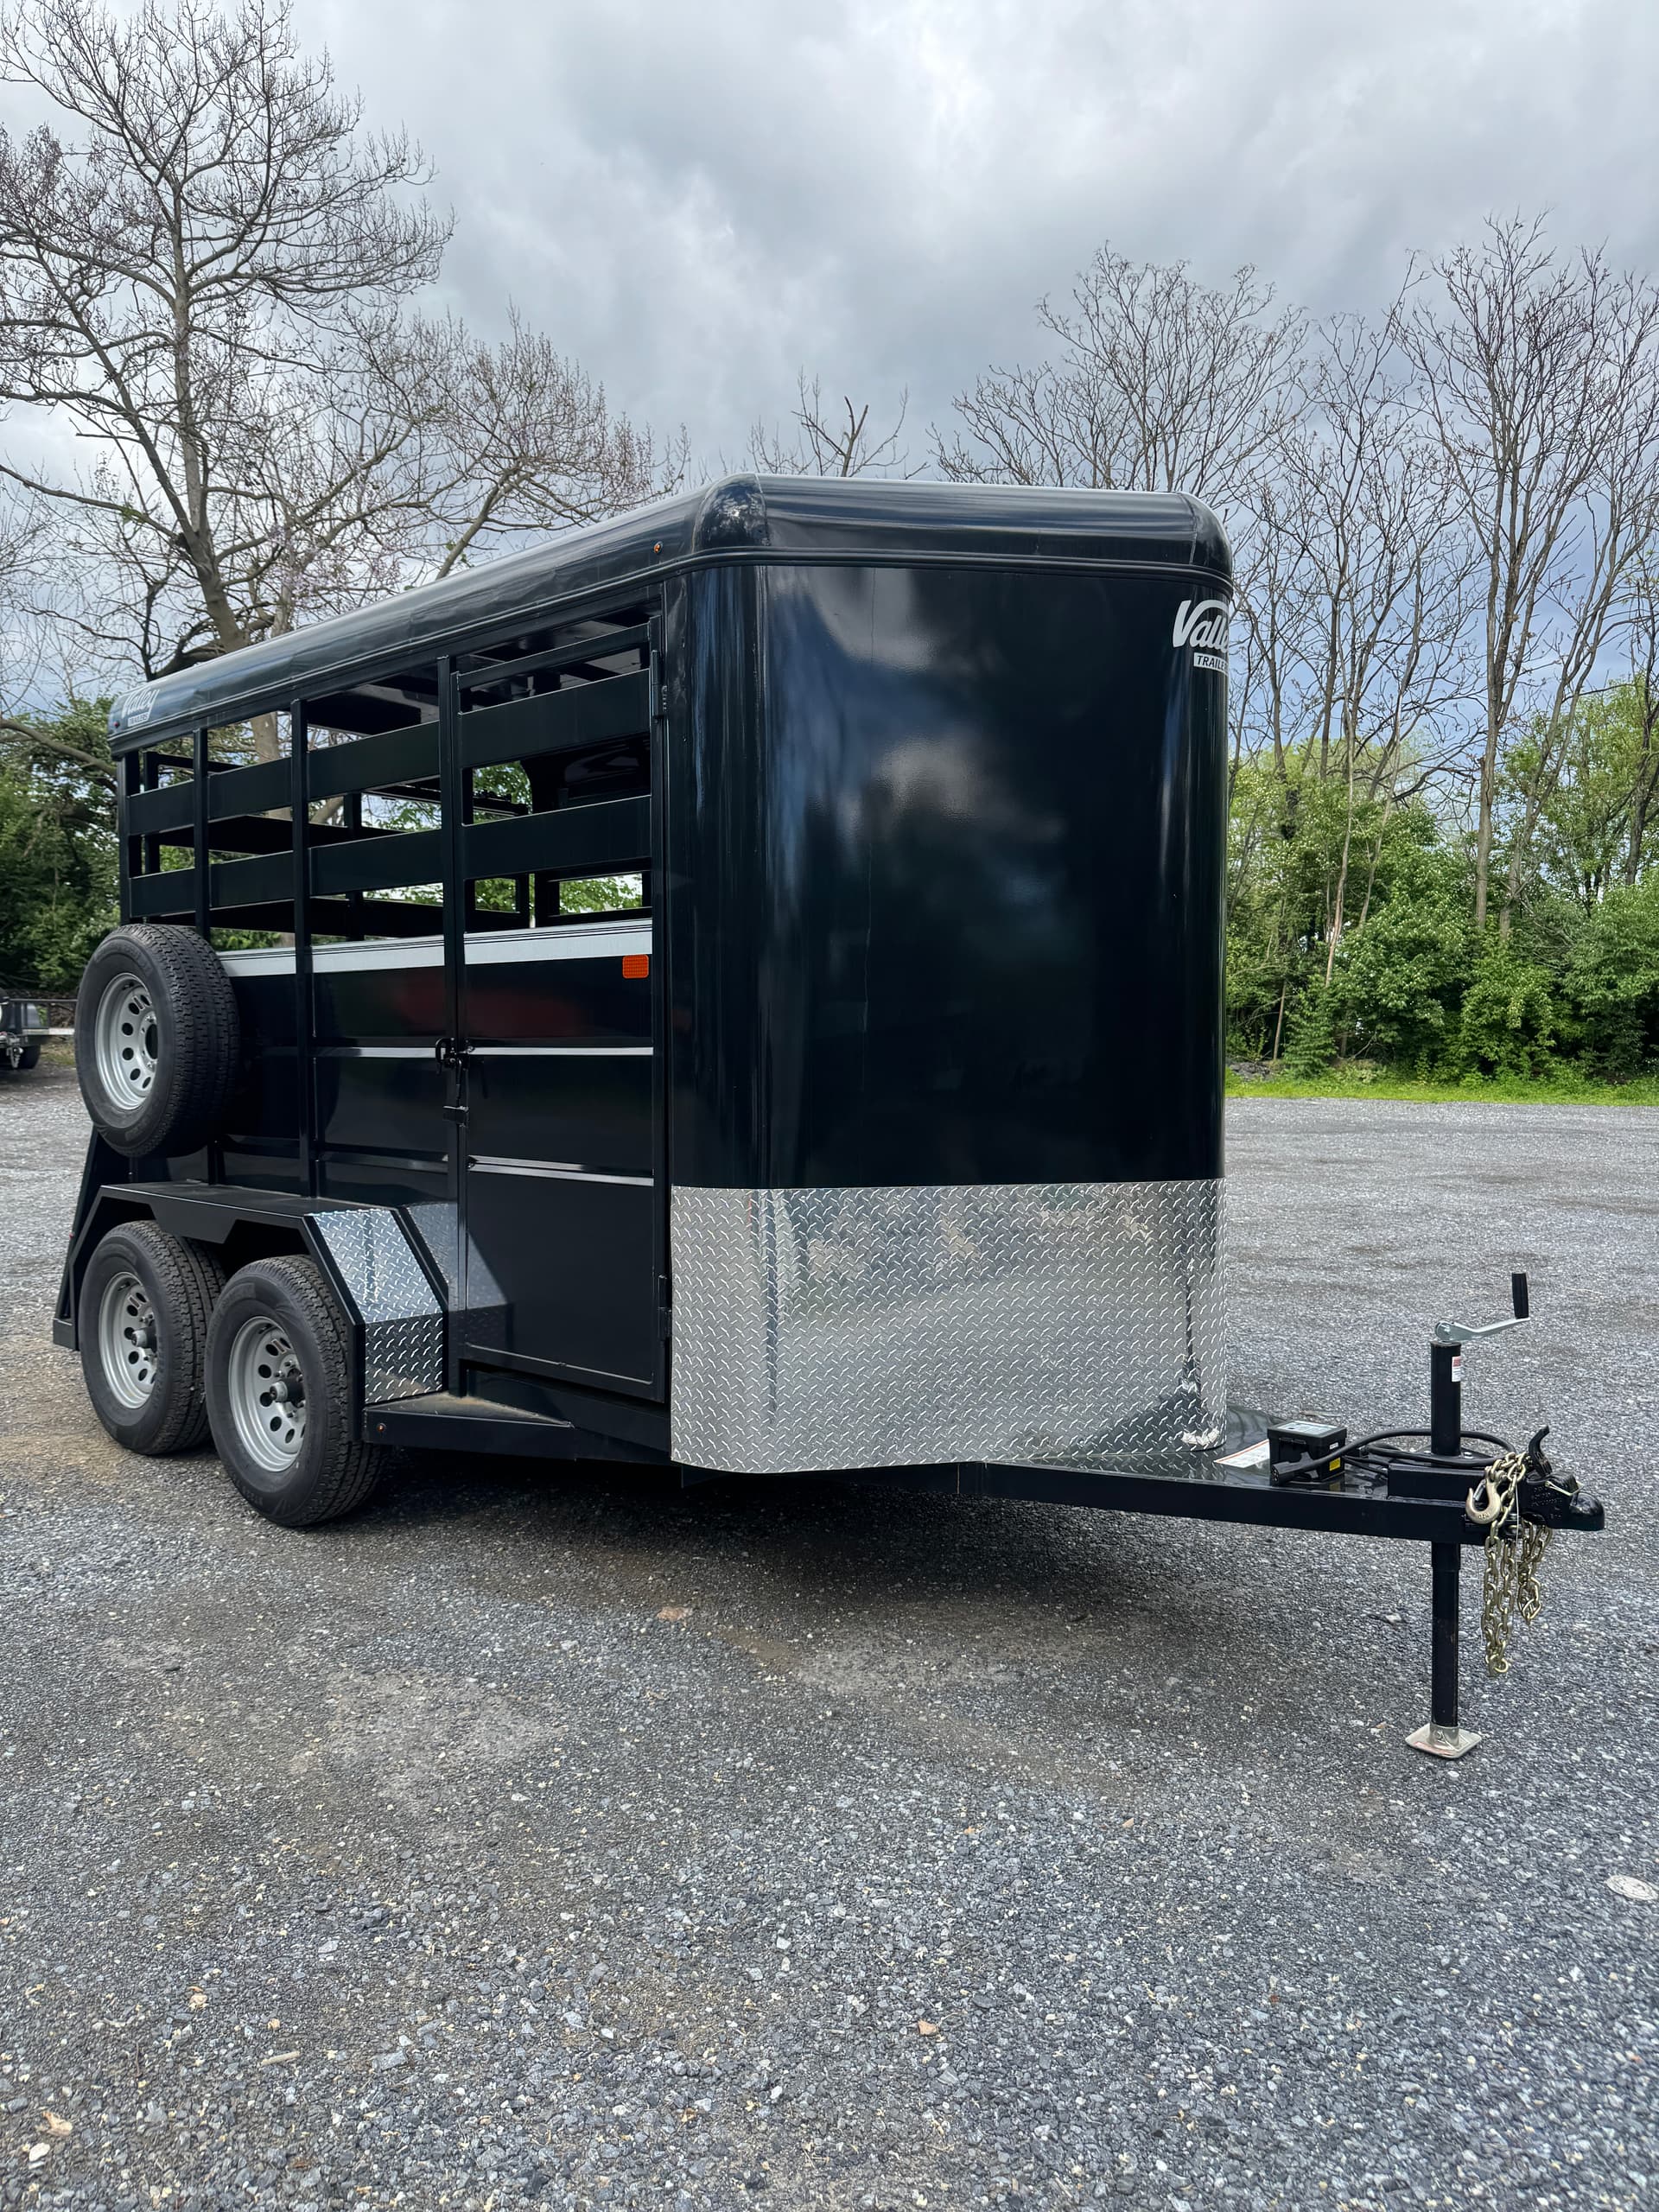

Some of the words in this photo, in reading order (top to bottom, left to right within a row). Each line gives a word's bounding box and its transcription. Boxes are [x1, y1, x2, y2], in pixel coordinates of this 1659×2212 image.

[1173, 600, 1229, 653] Valle
[1197, 655, 1228, 673] TRAILE
[121, 686, 160, 719] Valley
